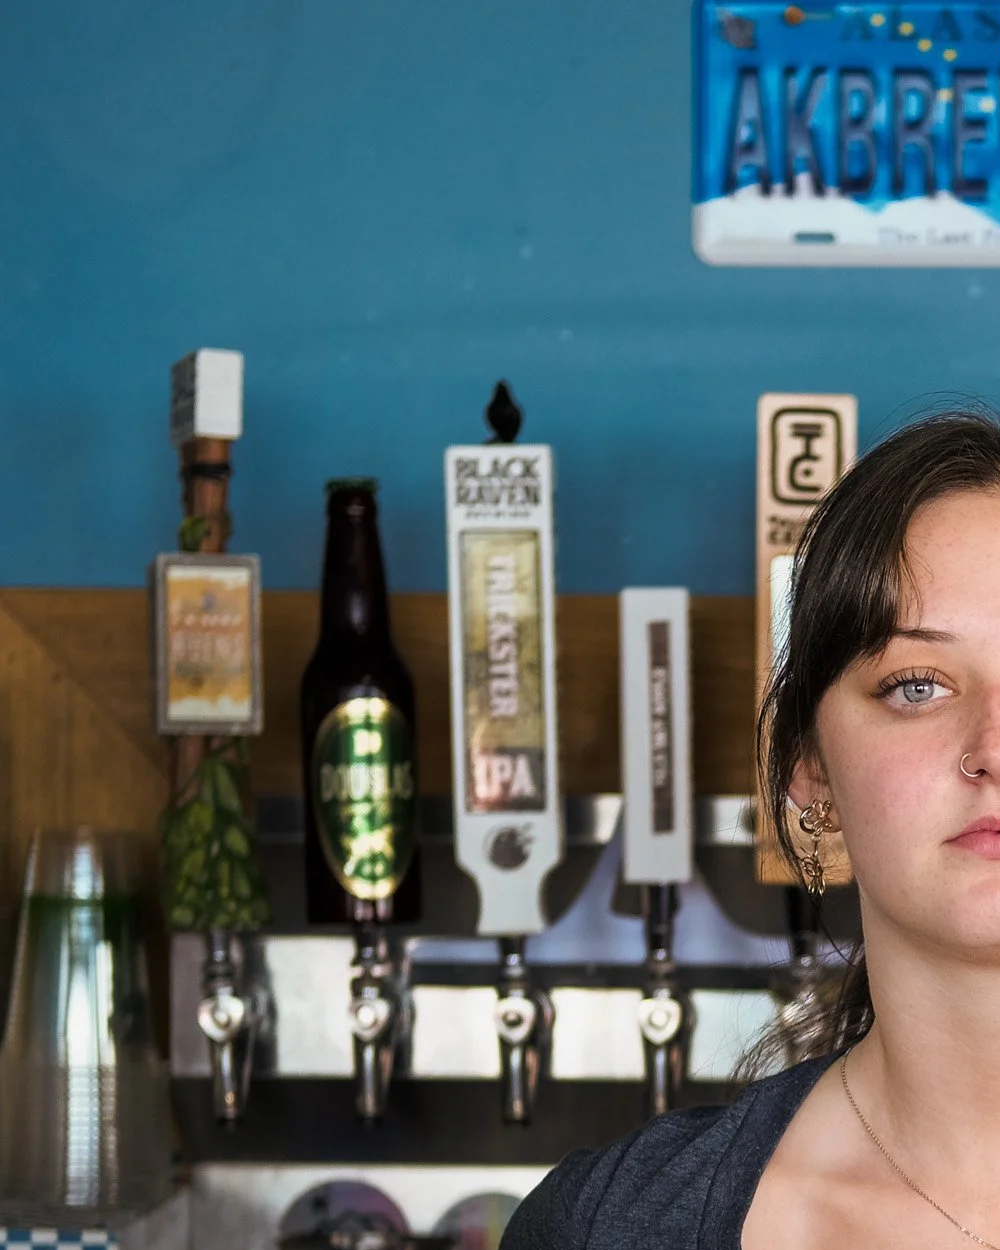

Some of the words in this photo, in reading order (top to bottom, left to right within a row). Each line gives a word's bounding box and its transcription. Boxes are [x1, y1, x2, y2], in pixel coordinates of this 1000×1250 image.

[456, 456, 541, 480] BLACK
[456, 480, 541, 507] RAVEN
[485, 556, 520, 719] TRICKSTER
[474, 752, 536, 801] IPA
